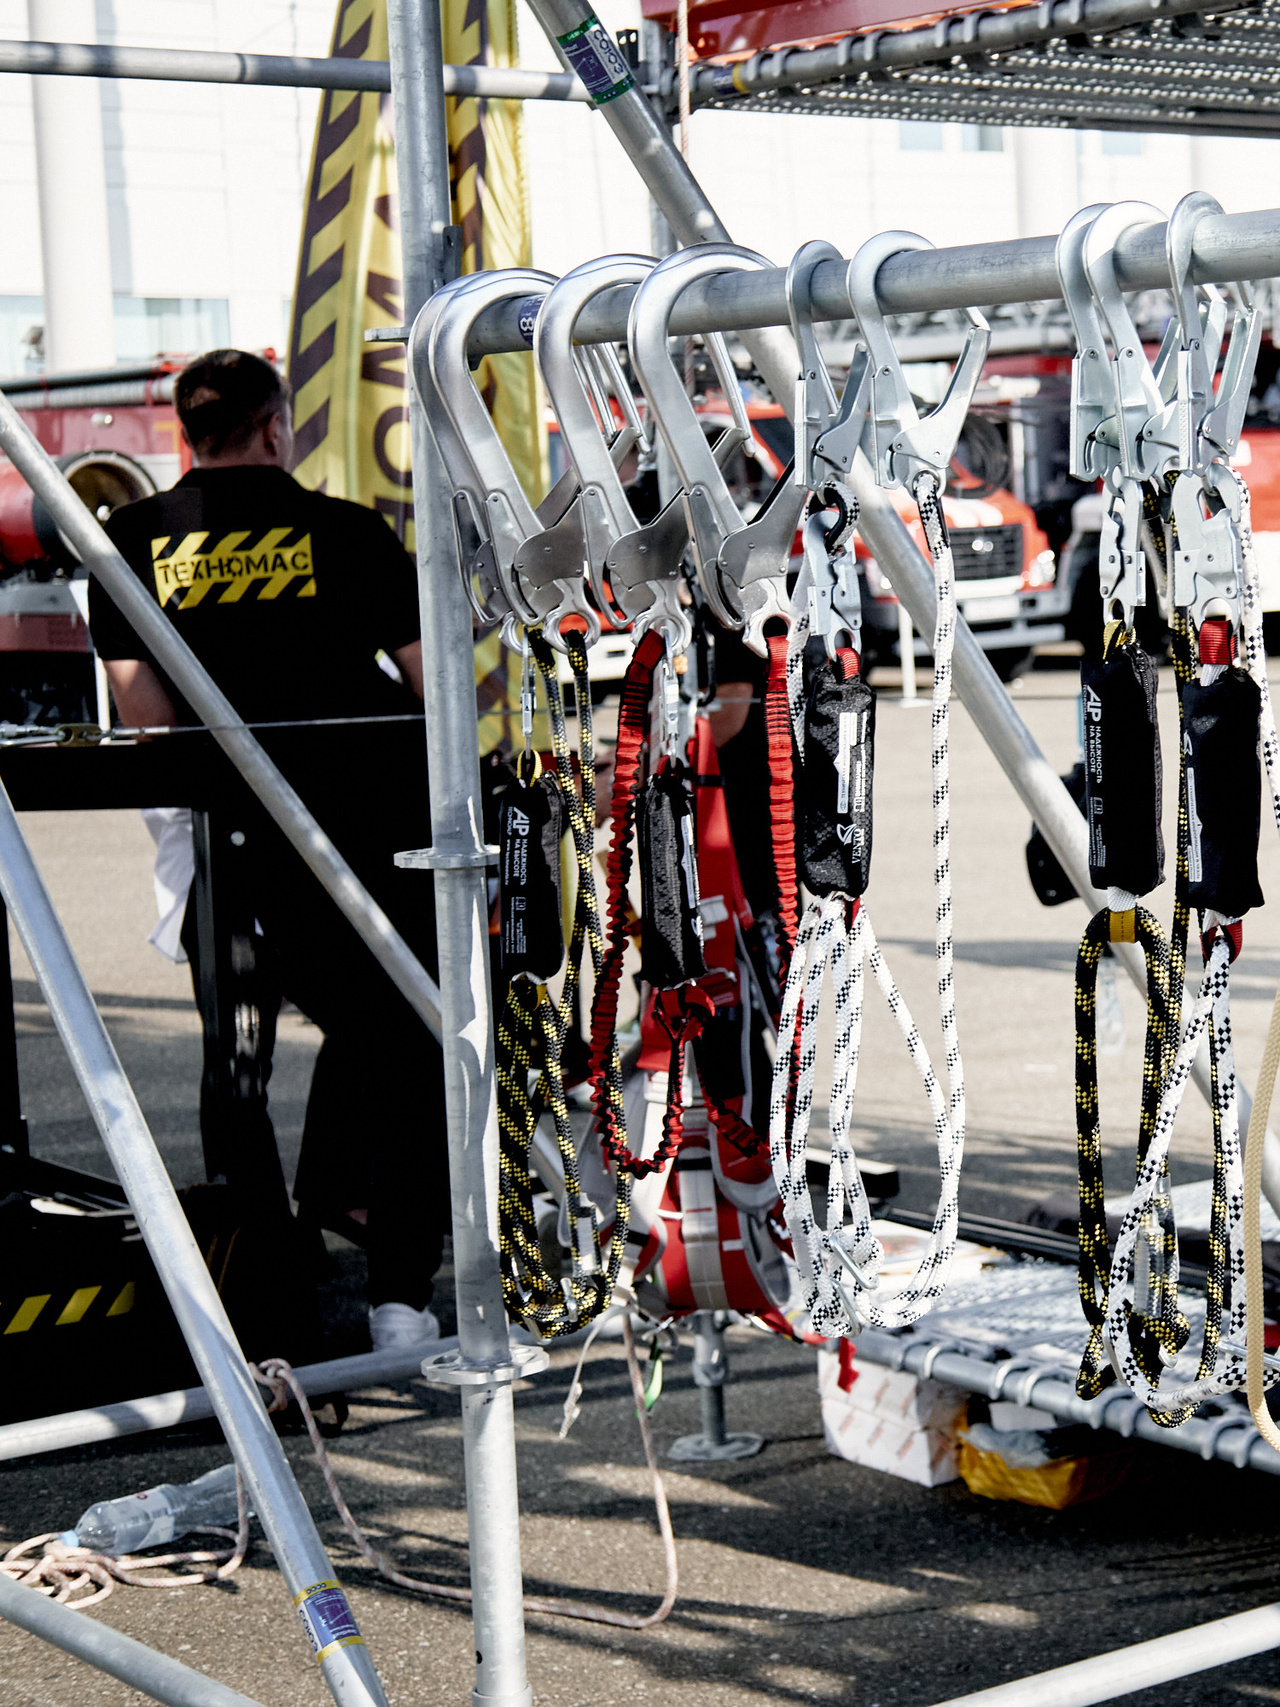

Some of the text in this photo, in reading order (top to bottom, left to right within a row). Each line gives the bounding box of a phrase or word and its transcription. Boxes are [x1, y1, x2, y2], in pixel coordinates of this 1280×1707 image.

[157, 552, 309, 584] ТЕХНОМАС
[1090, 726, 1097, 737] НА
[1095, 726, 1103, 784] НАДЕЖНОСТЬ
[514, 838, 521, 849] НА
[852, 828, 861, 864] VENTO
[520, 838, 528, 886] НАДЕЖНОСТЬ
